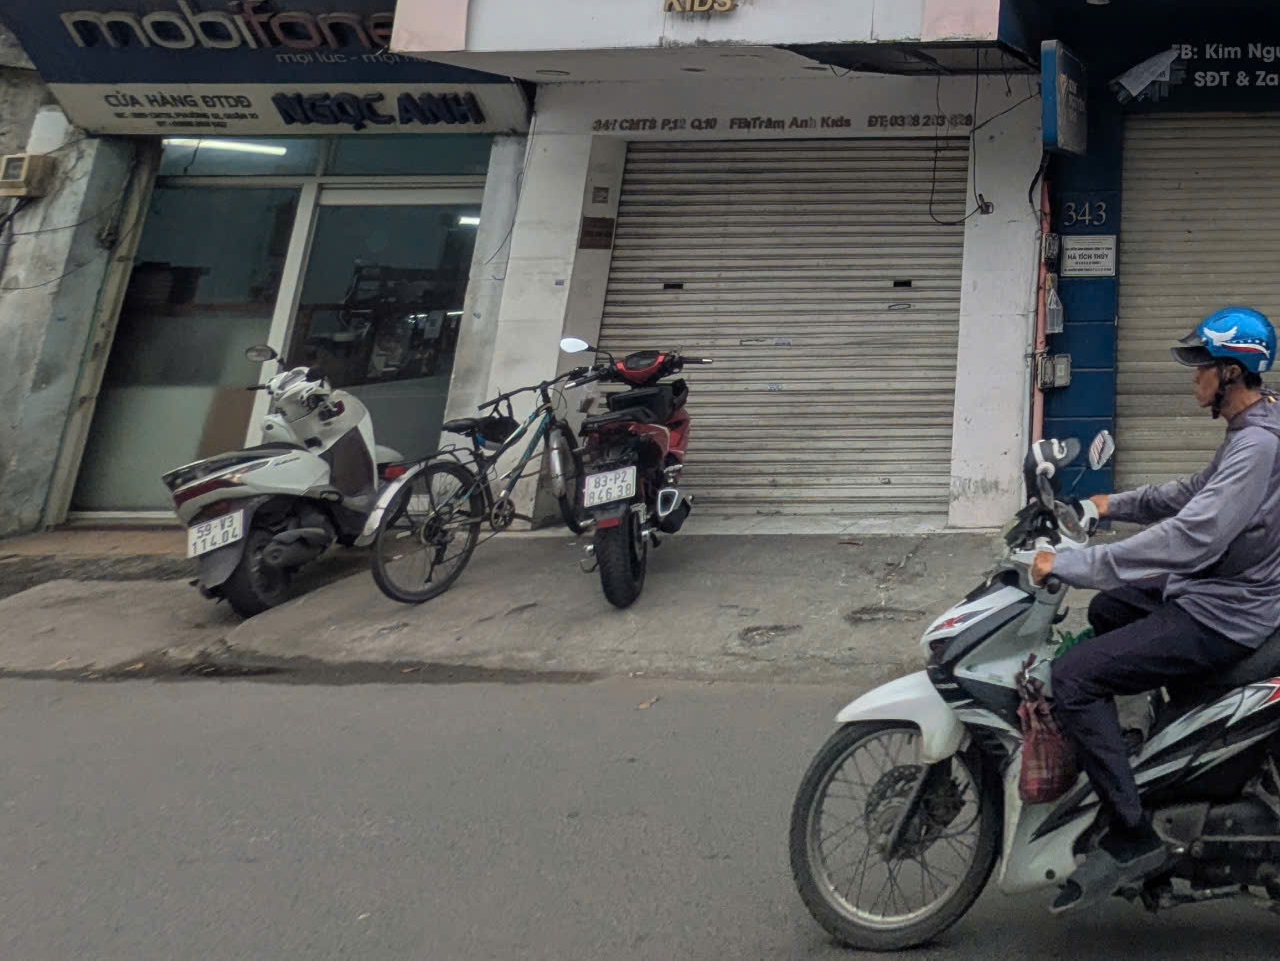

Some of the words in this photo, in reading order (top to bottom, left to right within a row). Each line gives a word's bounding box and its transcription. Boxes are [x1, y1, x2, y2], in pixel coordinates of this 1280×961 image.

[1205, 43, 1242, 60] Kim
[1194, 71, 1230, 87] SĐT
[1235, 71, 1250, 86] &
[148, 91, 198, 108] HÀNG
[271, 92, 396, 130] NGỌC
[396, 91, 487, 125] ANH
[820, 114, 852, 129] Kids
[1063, 202, 1107, 226] 343
[594, 470, 628, 489] 83-P2
[196, 515, 234, 540] 59-V3
